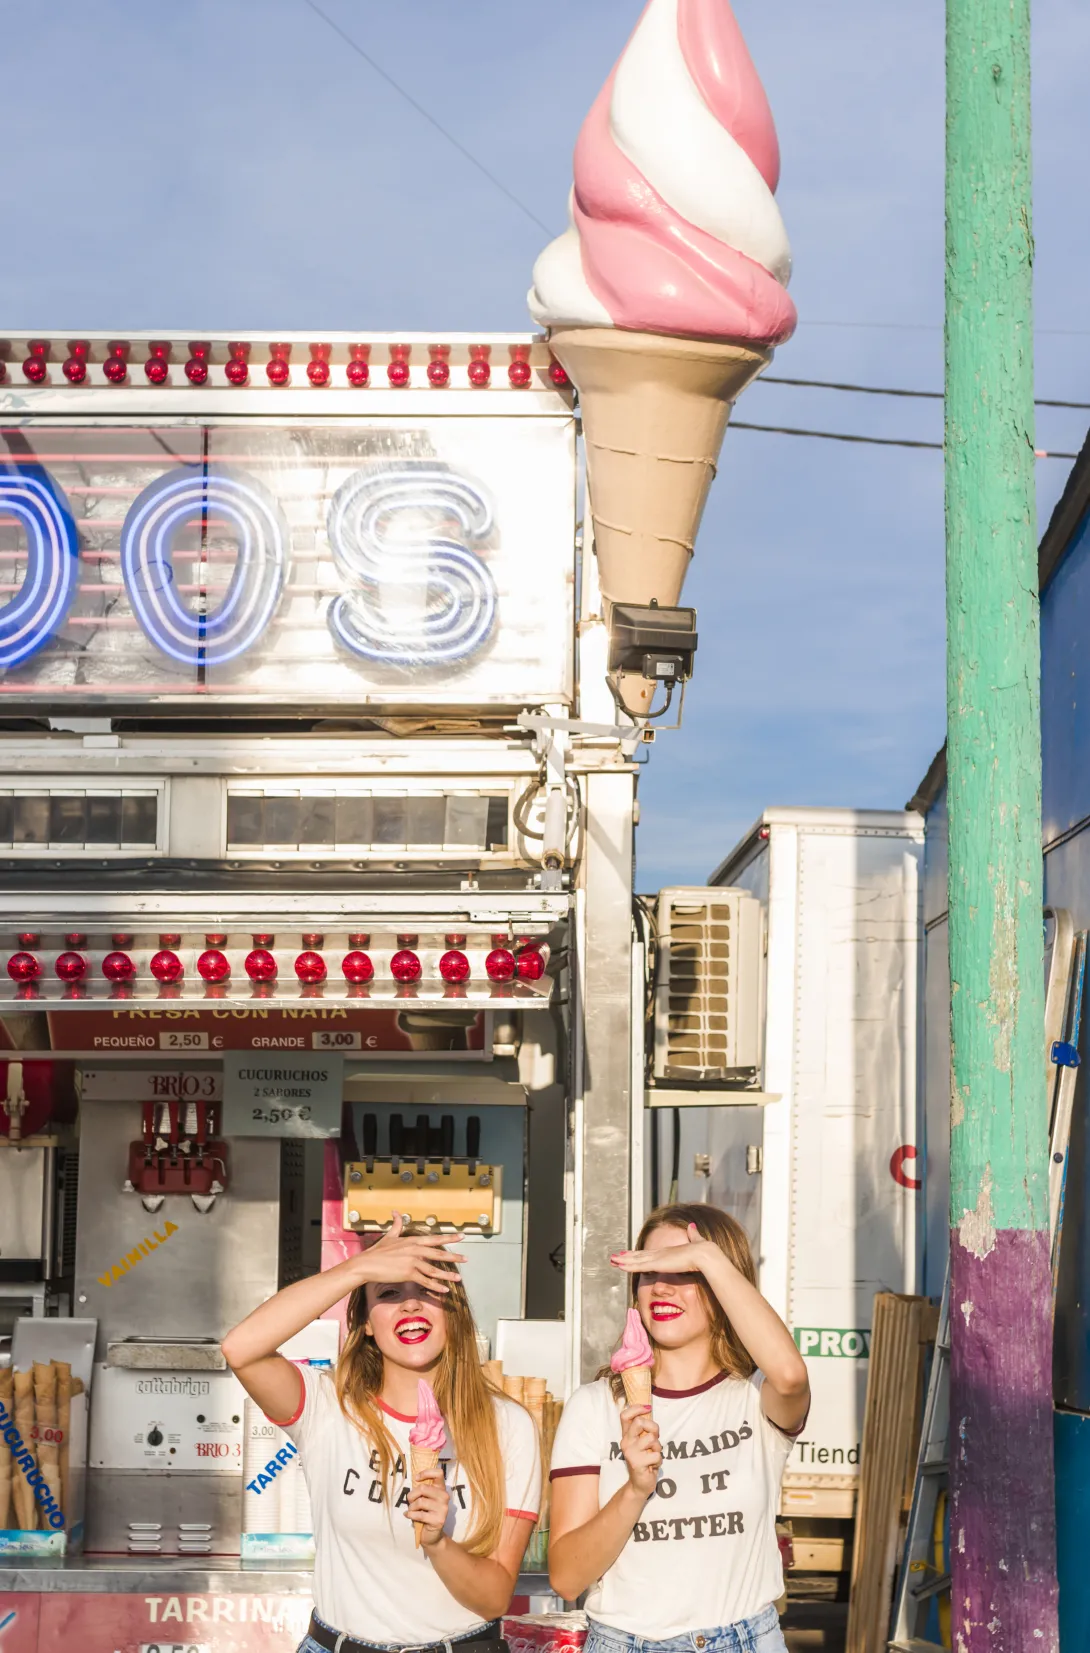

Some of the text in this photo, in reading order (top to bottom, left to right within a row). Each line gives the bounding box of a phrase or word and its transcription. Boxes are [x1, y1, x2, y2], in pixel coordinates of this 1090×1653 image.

[93, 1033, 224, 1048] PEQUEÑO 2,50 €
[251, 1033, 378, 1048] GRANDE 3,00 €
[238, 1069, 329, 1082] CUCURUCHOS
[202, 1076, 216, 1096] 3
[262, 1088, 312, 1098] SABORES
[252, 1108, 293, 1123] 2,50
[98, 1221, 179, 1287] VAINILLA
[136, 1377, 210, 1396] cattabriga
[609, 1420, 753, 1461] MMAIDS
[194, 1442, 241, 1459] BRIO 3
[368, 1449, 451, 1480] EAT
[343, 1468, 466, 1509] COAT
[700, 1469, 730, 1494] IT
[632, 1511, 744, 1543] BETTER
